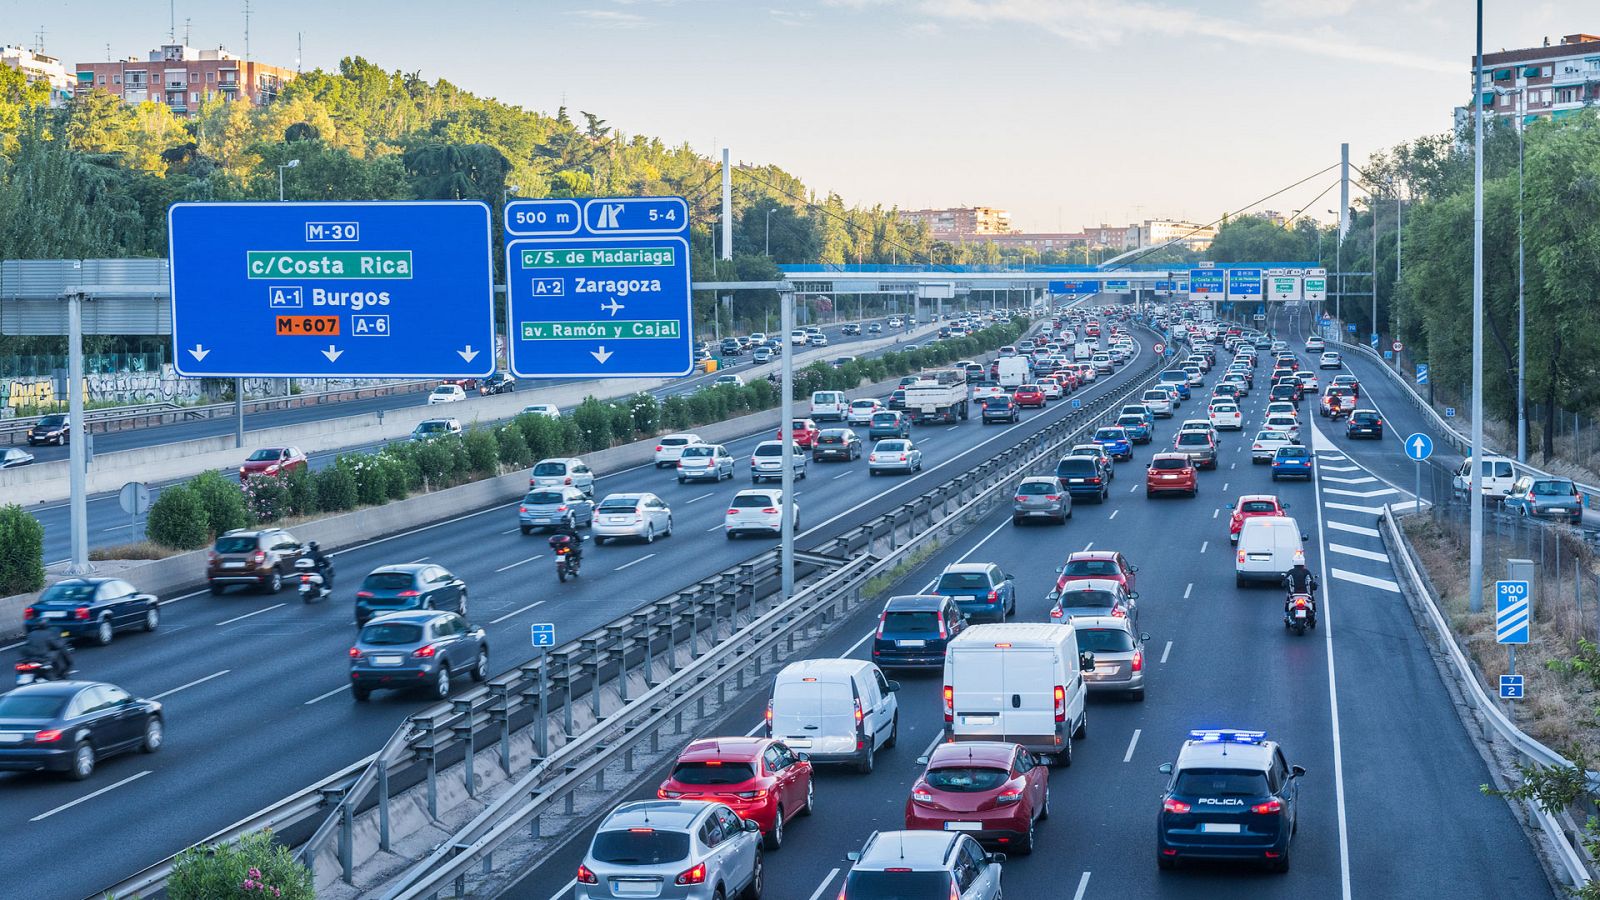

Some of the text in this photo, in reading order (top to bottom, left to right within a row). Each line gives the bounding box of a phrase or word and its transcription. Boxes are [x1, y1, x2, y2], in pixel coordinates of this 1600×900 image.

[516, 212, 570, 224] 500 m
[648, 210, 676, 222] 5-4
[310, 225, 356, 239] M-30
[525, 249, 673, 265] c/S. de Madariaga
[252, 256, 408, 275] c/Costa Rica
[536, 278, 662, 296] A-2 Zaragoza
[274, 289, 390, 310] A-1 Burgos
[279, 319, 386, 332] M-607 A-6
[524, 322, 677, 339] av. Ramón y Cajal
[1500, 584, 1524, 595] 300
[539, 634, 547, 643] 2
[1507, 687, 1515, 696] 2
